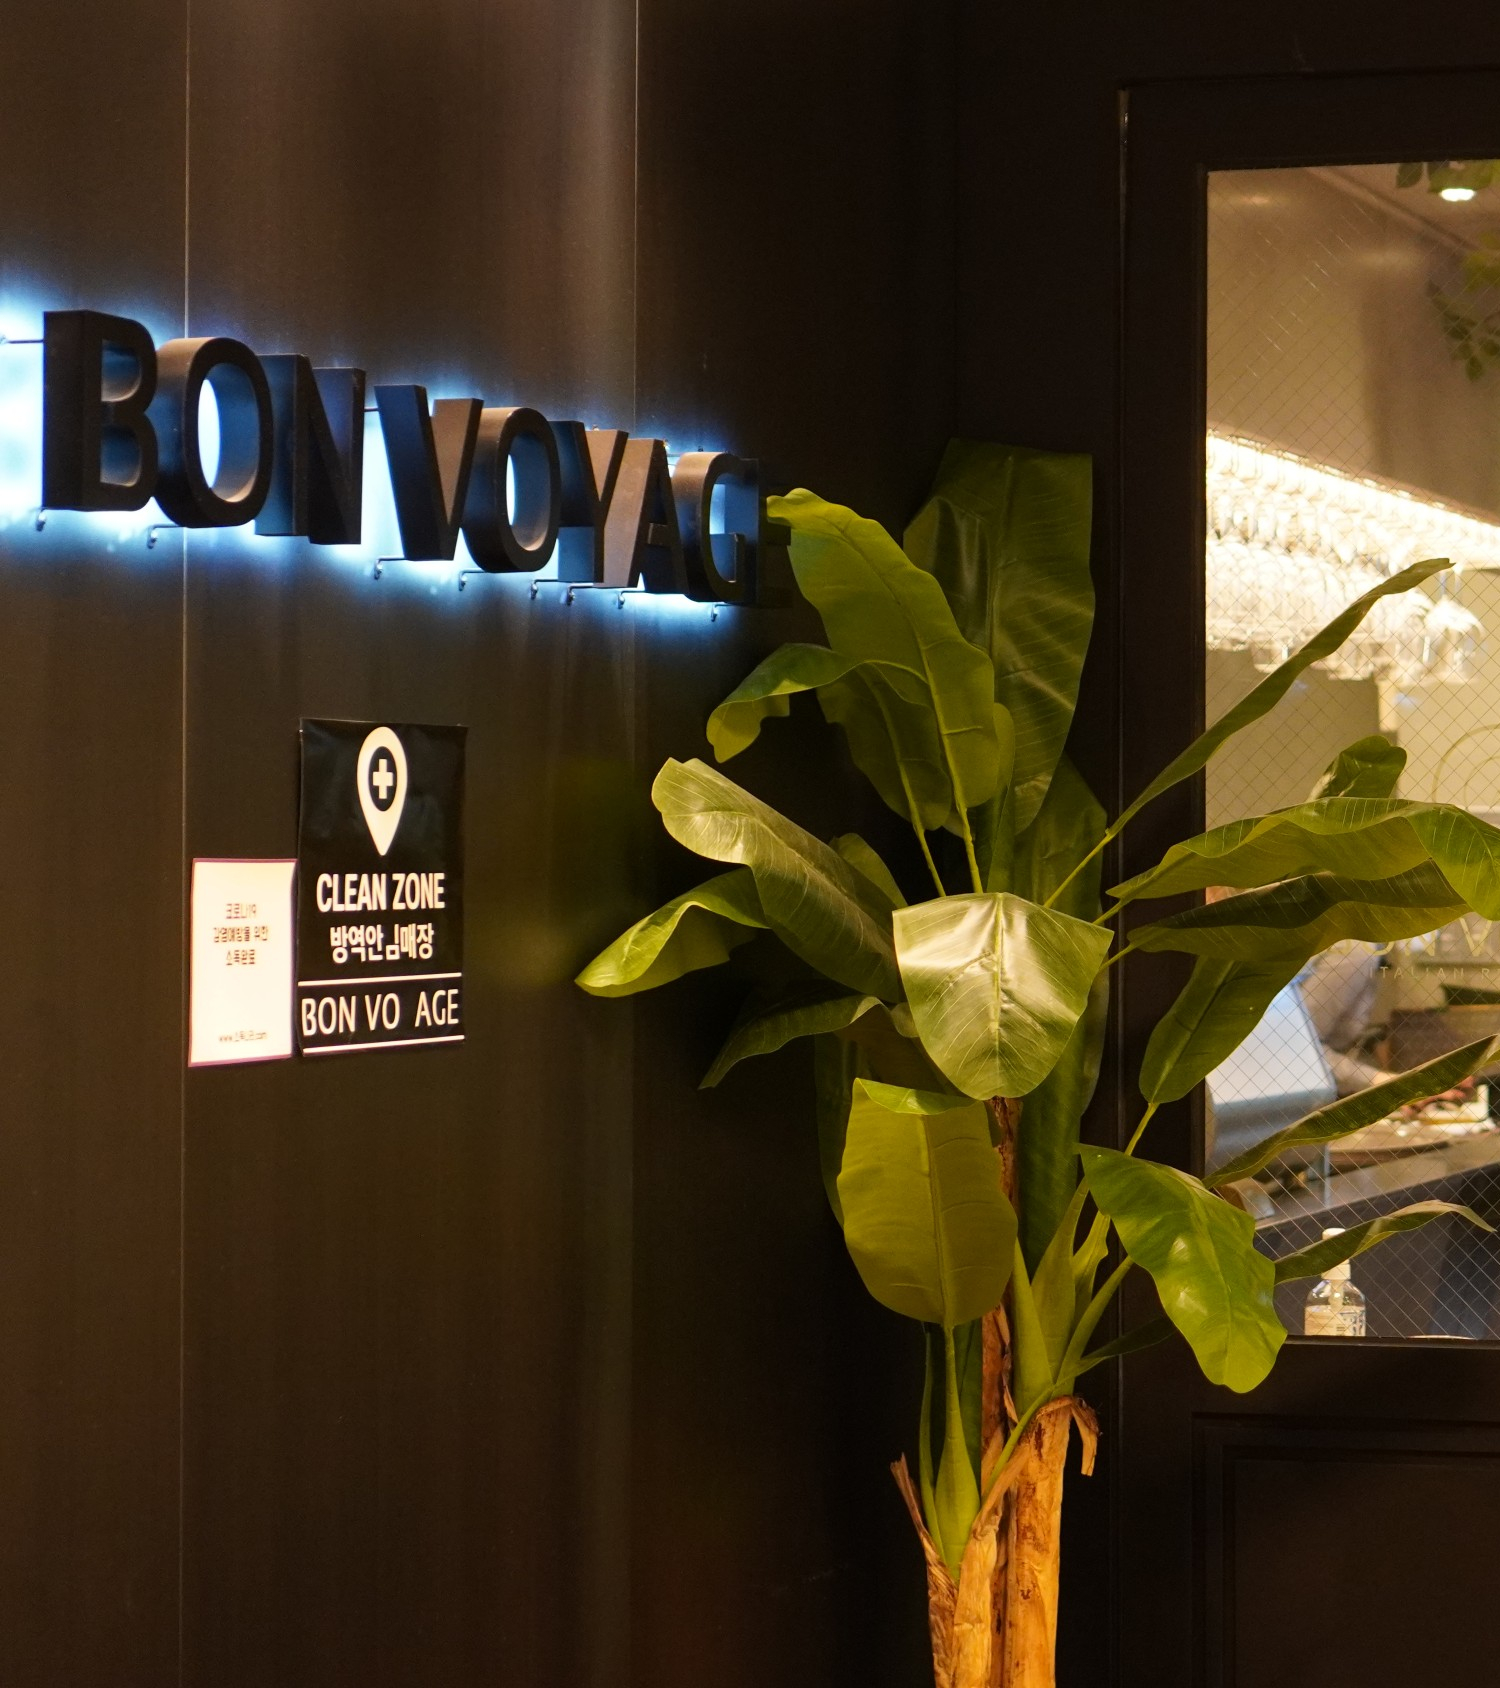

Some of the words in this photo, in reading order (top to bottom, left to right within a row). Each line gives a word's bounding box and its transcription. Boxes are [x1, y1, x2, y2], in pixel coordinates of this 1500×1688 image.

[43, 310, 366, 545] BON
[316, 873, 386, 912] CLEAN
[392, 873, 446, 910] ZONE
[302, 996, 356, 1037] BON
